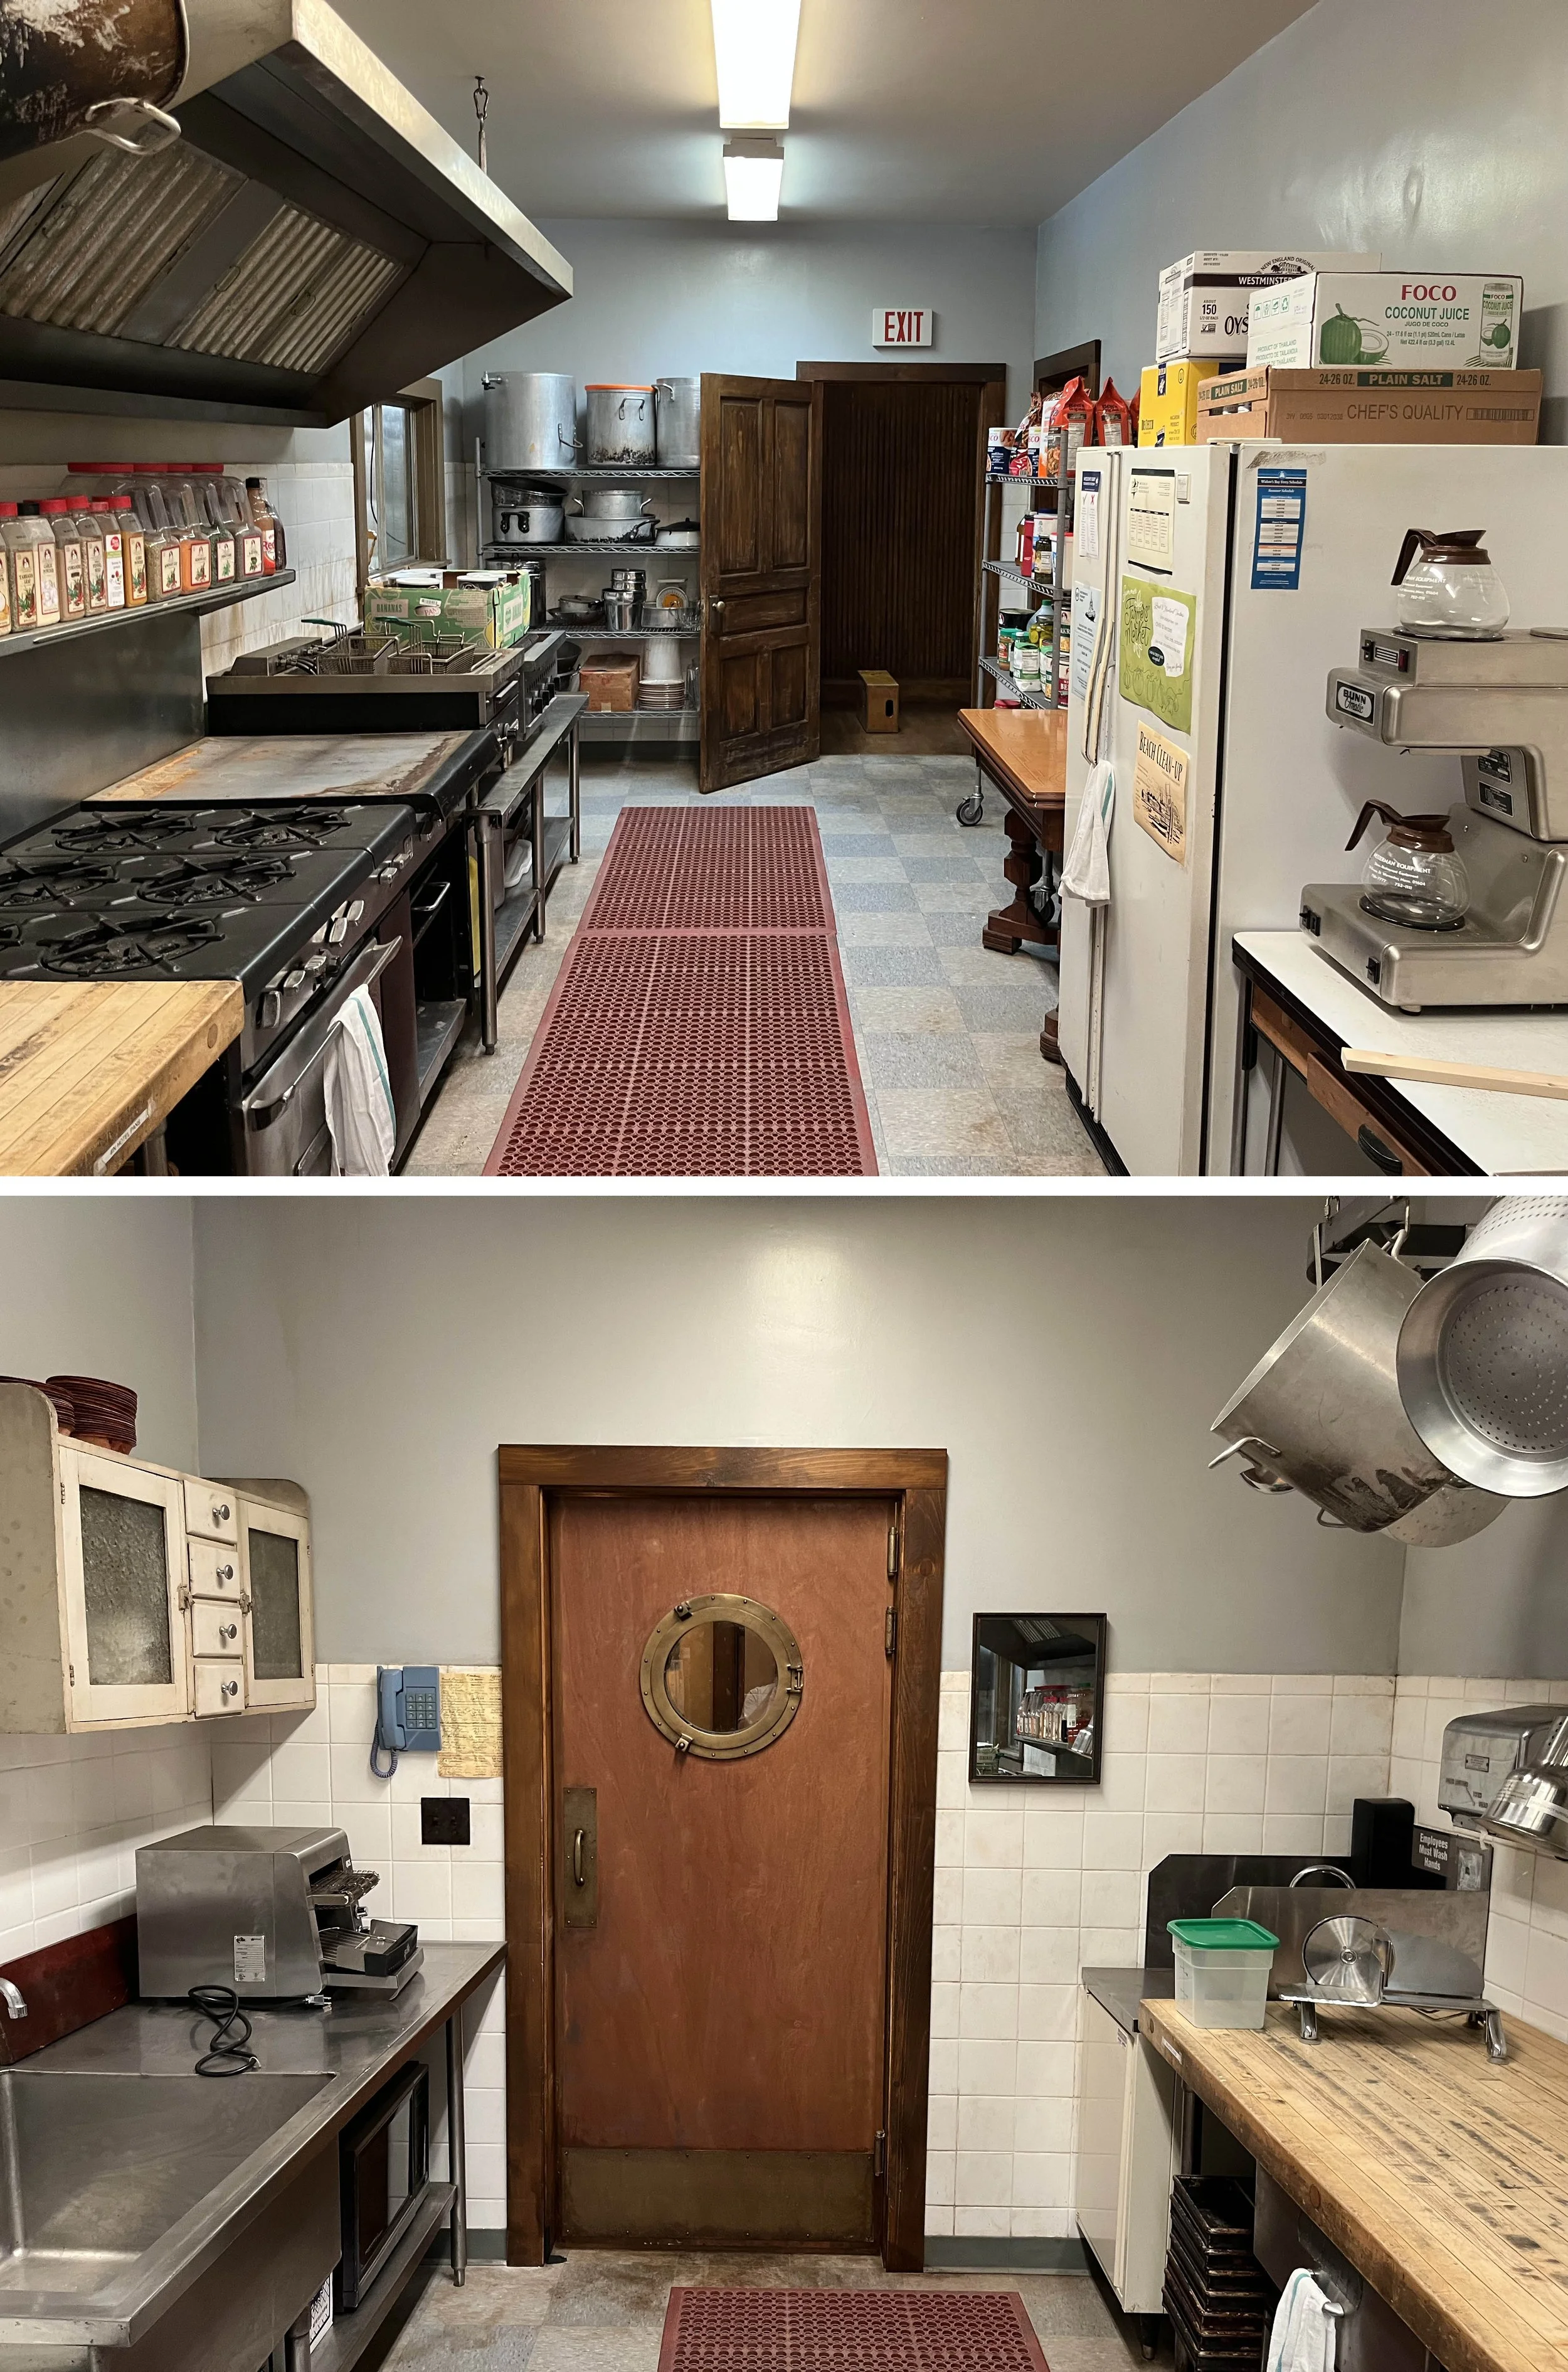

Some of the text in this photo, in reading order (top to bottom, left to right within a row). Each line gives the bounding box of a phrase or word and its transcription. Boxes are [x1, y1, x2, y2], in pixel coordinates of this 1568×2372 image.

[1260, 257, 1316, 272] NEW ENGLAND ORIGINAL
[1401, 285, 1456, 302] FOCO
[1202, 304, 1217, 315] 150
[1483, 300, 1513, 310] COCONUT JUICE
[1385, 307, 1470, 321] COCONUT JUICE
[884, 312, 924, 342] EXIT
[1258, 344, 1273, 353] PRODUCT
[1279, 339, 1296, 349] THAILAND
[1255, 353, 1273, 361] PRODUCTO
[1319, 375, 1491, 386] 24-26 OZ. PLAIN SALT 24-26 OZ.
[1214, 386, 1229, 398] PLAIN
[1231, 382, 1244, 394] SALT
[1347, 404, 1463, 421] CHEF'S QUALITY
[376, 604, 402, 613] BANANAS
[1125, 598, 1150, 625] Farmers'
[1125, 620, 1151, 646] Market
[1343, 689, 1366, 705] BUNN
[1139, 731, 1183, 782] BEACH CLEAN-UP
[1396, 862, 1431, 874] EQUIPMENT
[1419, 1832, 1448, 1849] Employees
[1419, 1844, 1448, 1861] Must Wash
[1424, 1856, 1441, 1871] Hands
